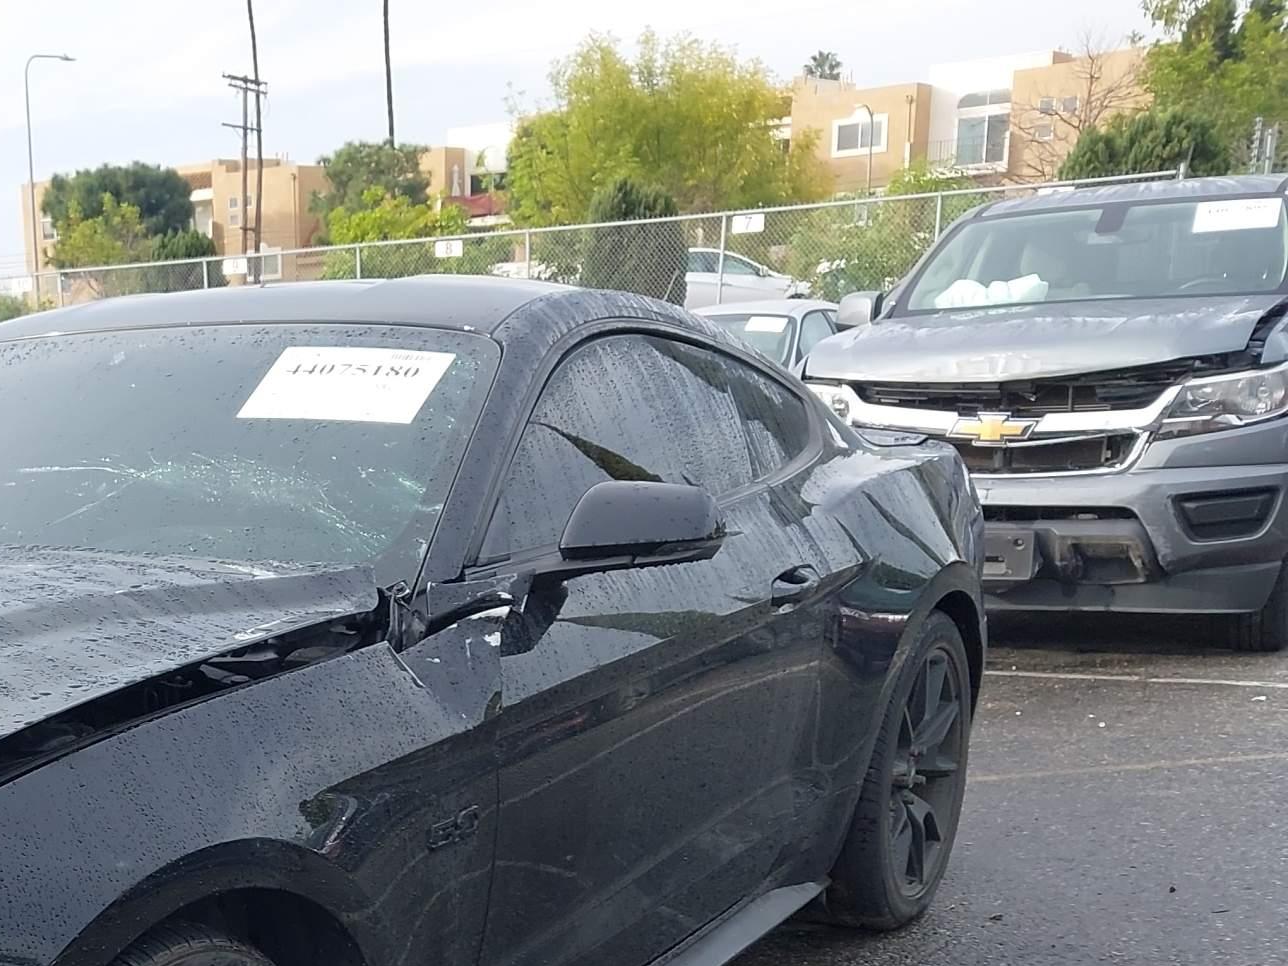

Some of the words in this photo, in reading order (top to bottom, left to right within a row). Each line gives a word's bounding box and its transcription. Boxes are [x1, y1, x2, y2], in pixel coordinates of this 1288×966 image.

[744, 215, 753, 231] 7
[445, 241, 453, 255] 8
[286, 363, 420, 378] 44075180
